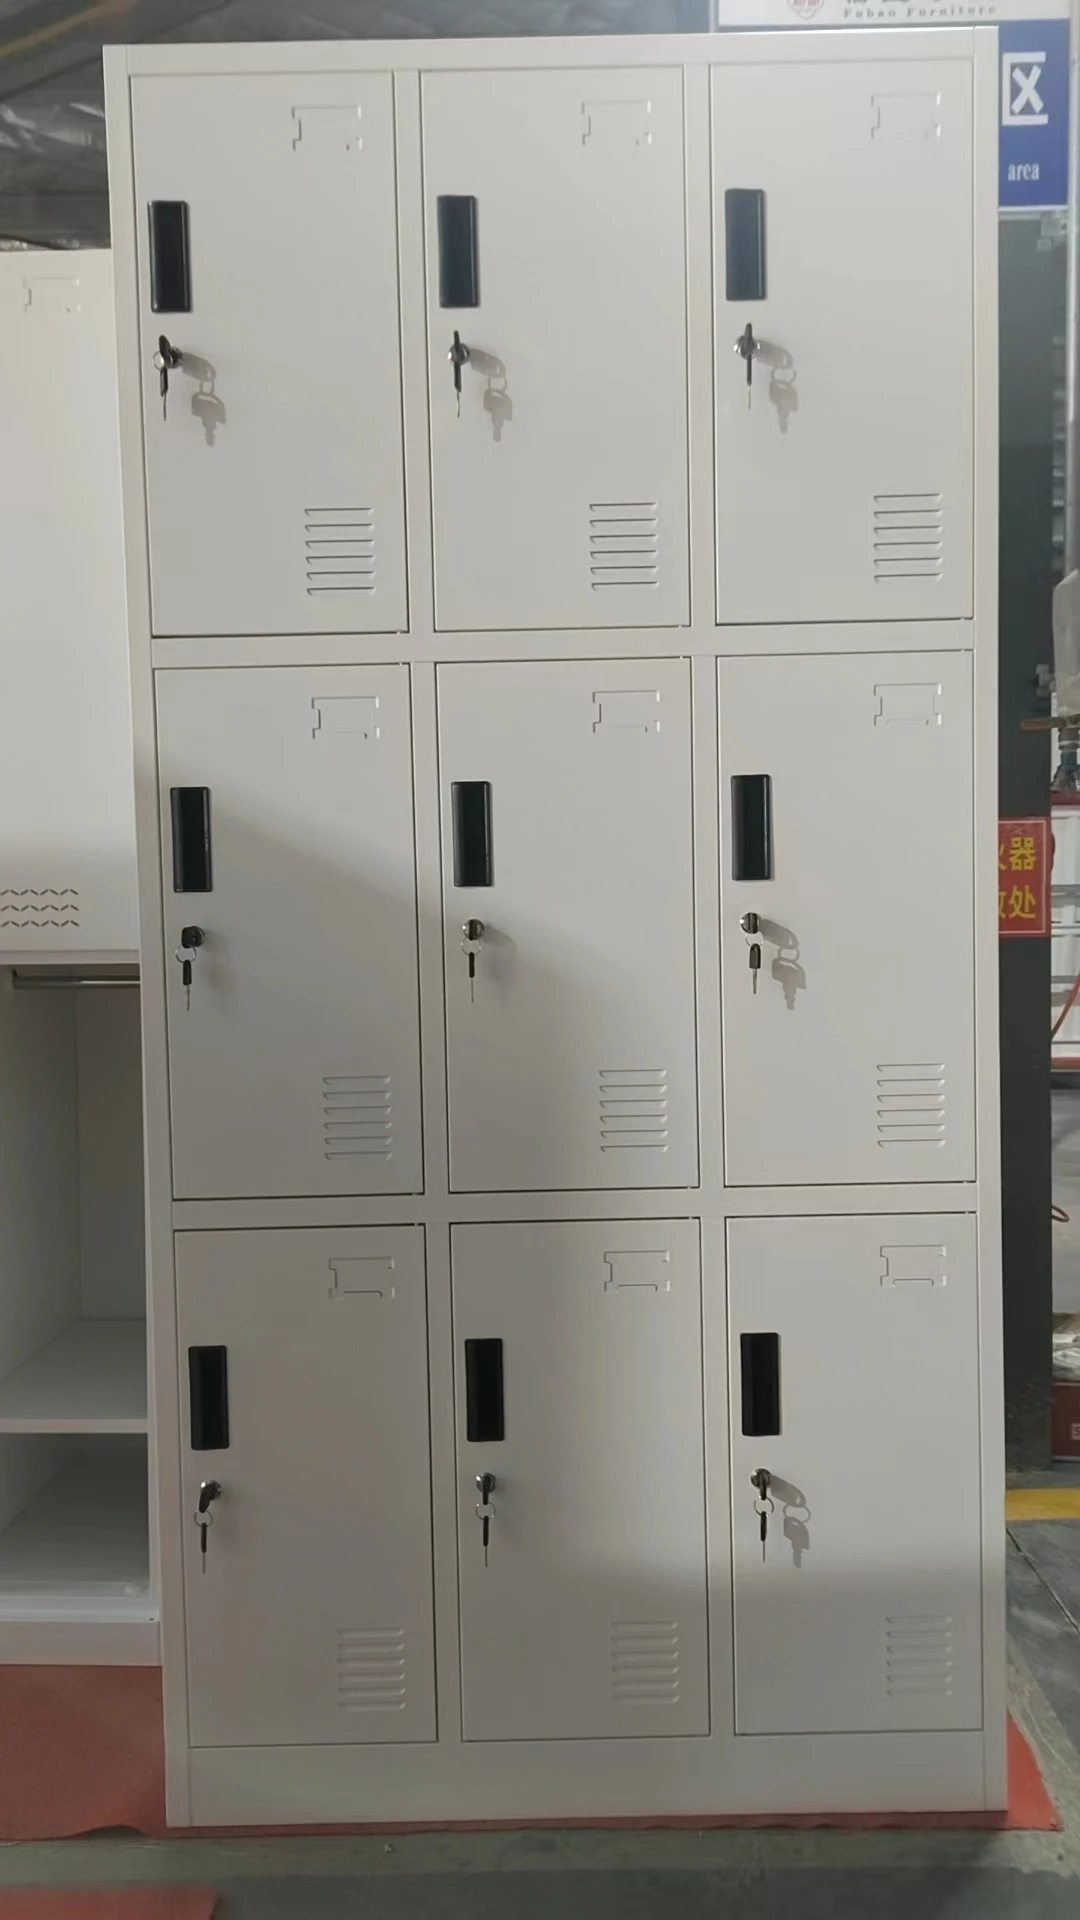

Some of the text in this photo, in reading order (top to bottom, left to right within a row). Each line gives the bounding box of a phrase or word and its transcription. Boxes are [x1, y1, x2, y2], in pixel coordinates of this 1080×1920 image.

[844, 4, 996, 18] Fubao Furniture
[1002, 51, 1049, 126] 区
[1007, 162, 1040, 181] area
